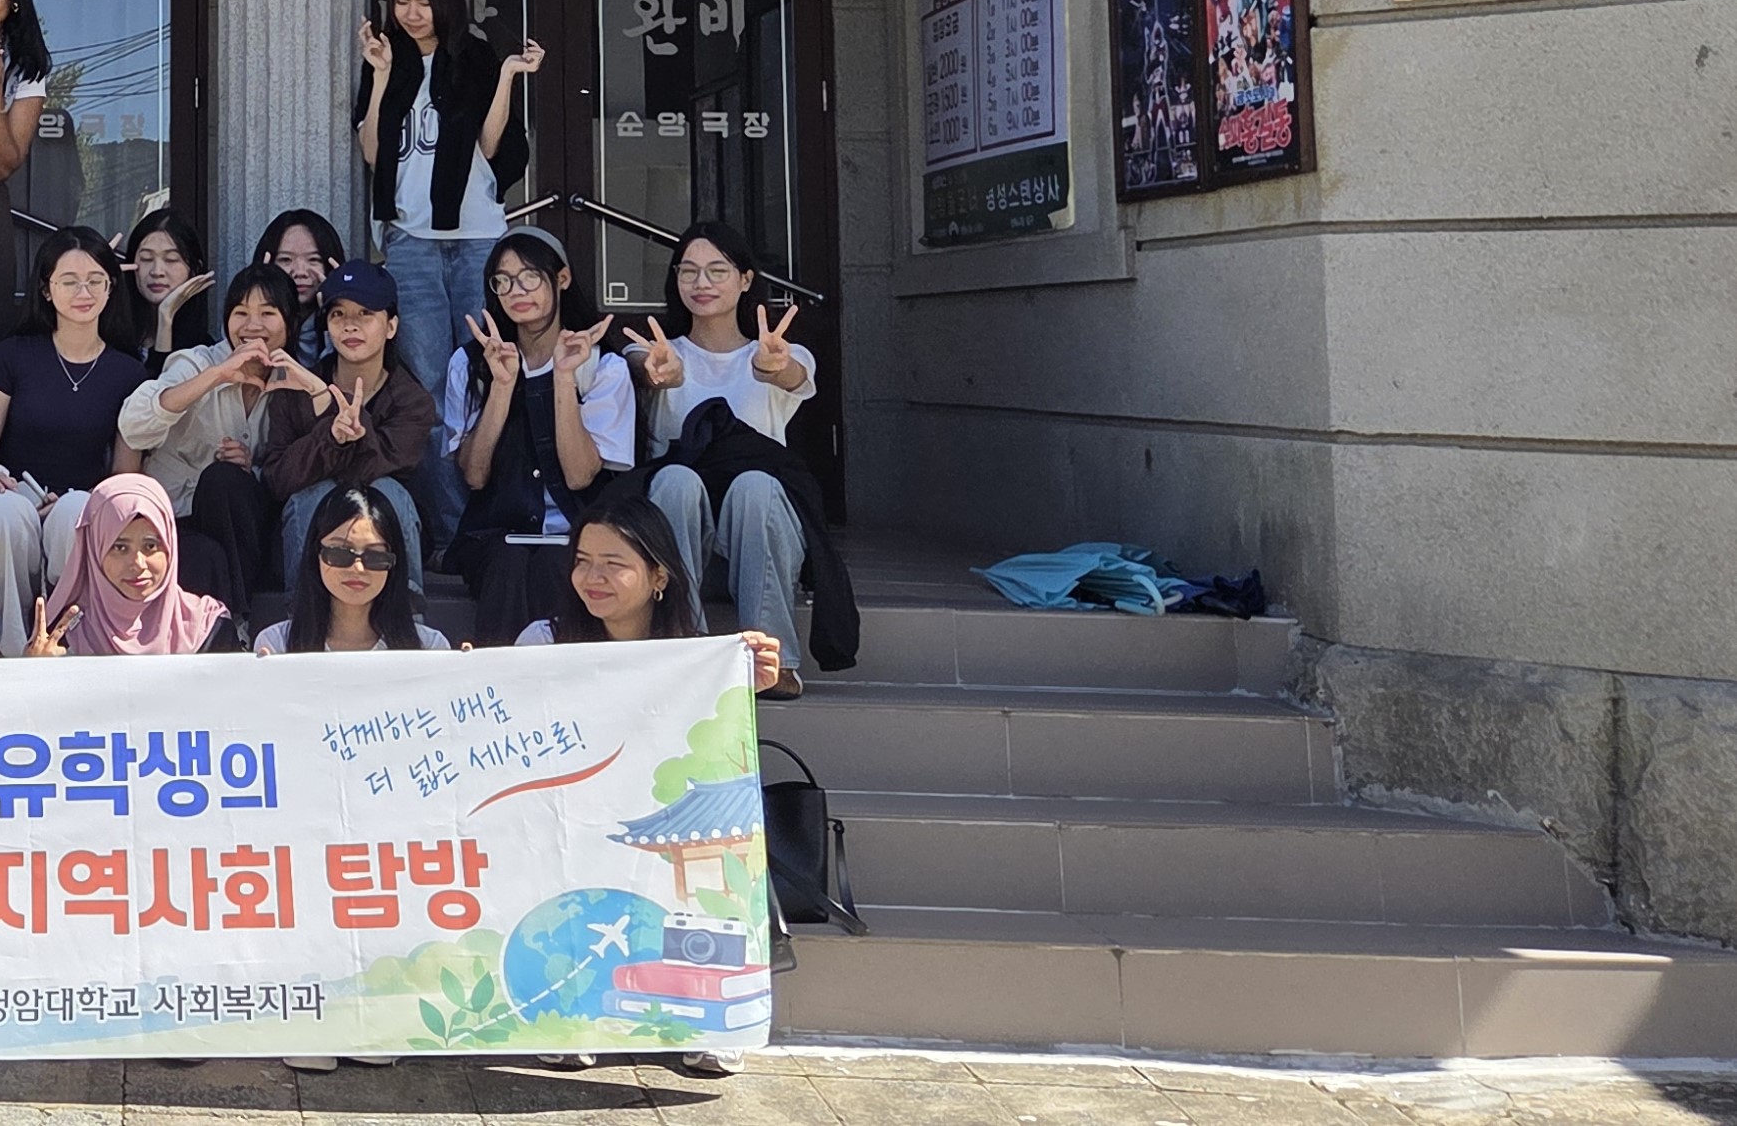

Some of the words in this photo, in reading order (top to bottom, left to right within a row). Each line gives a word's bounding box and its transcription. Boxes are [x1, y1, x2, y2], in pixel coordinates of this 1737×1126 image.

[615, 110, 771, 139] 순양극장
[321, 707, 443, 761] 함께하는
[450, 685, 512, 725] 배움
[364, 765, 394, 795] 더
[408, 749, 460, 798] 넓은
[469, 720, 587, 769] 세상으로!
[327, 837, 490, 931] 탐방
[153, 979, 326, 1023] 사회복지과
